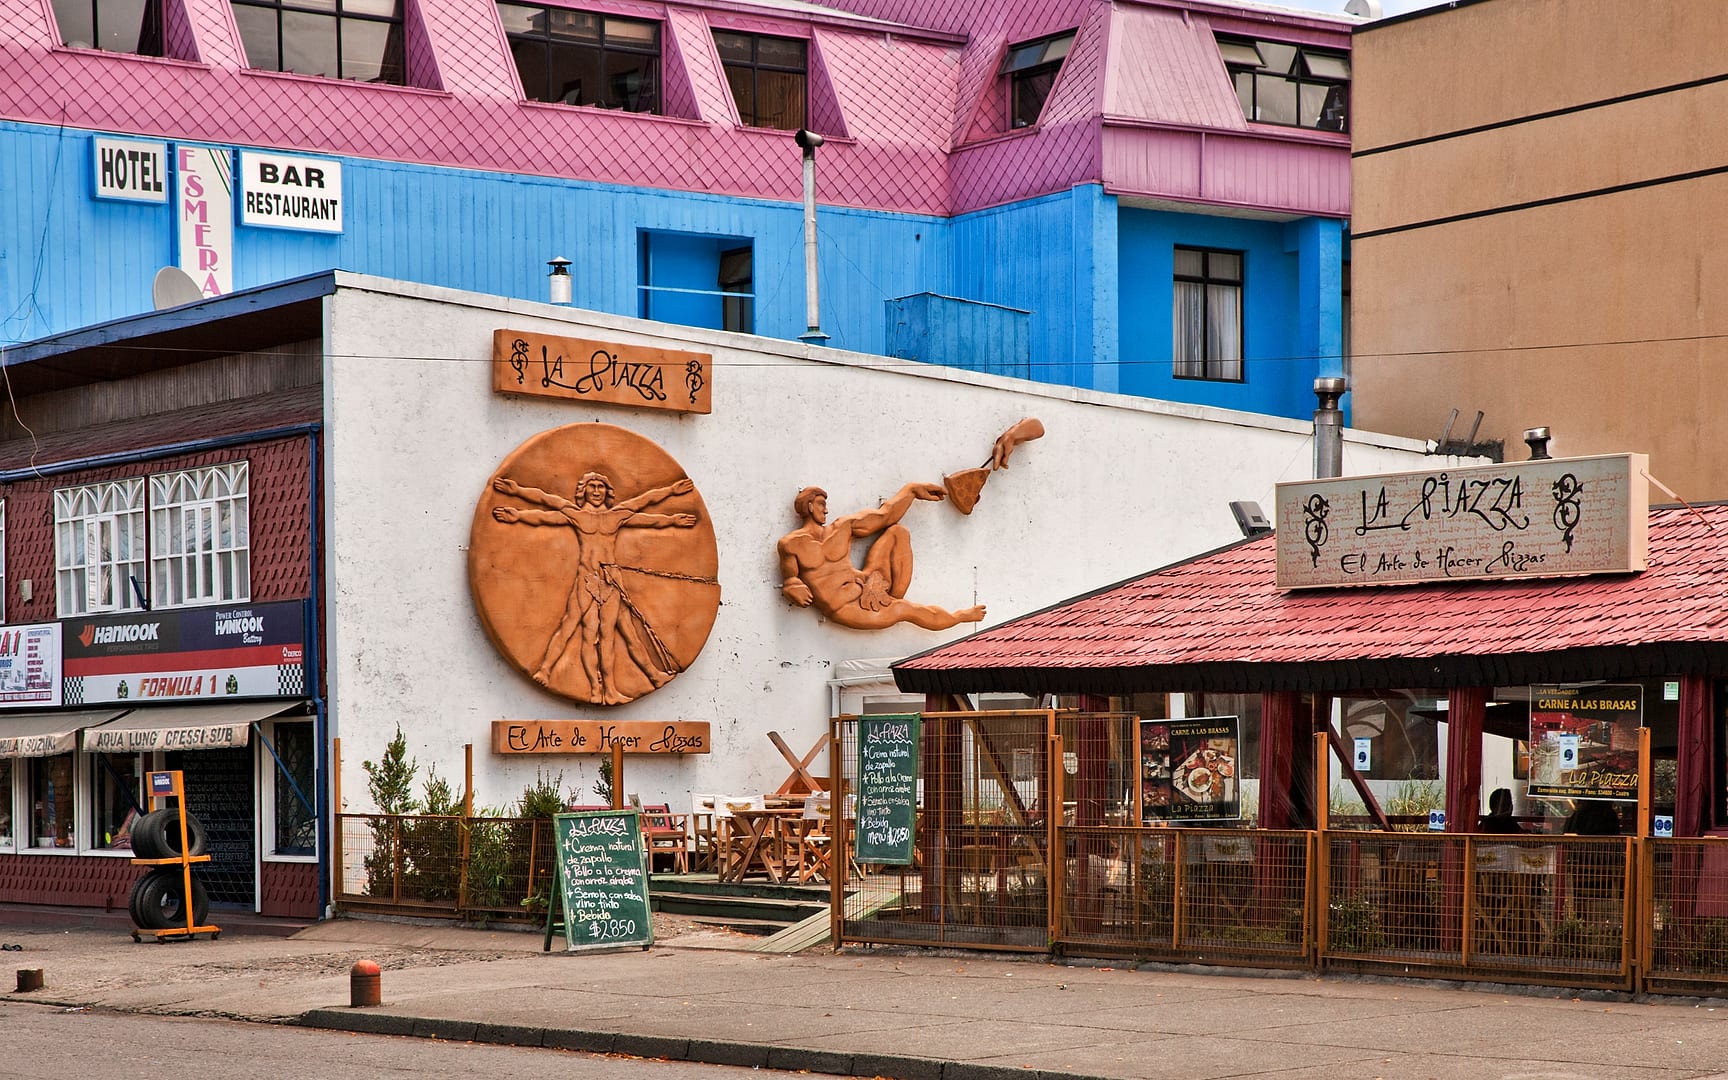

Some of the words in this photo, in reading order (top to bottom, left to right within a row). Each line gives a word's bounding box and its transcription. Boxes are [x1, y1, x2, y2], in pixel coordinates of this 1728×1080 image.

[101, 147, 163, 192] HOTEL
[259, 162, 325, 188] BAR
[246, 190, 338, 221] RESTAURANT
[1355, 485, 1404, 535] LA
[1403, 472, 1529, 531] PIAZZA
[1341, 556, 1366, 574] El
[1372, 550, 1406, 575] Arte
[1413, 550, 1430, 569] de
[1437, 546, 1483, 577] Hacer
[1485, 540, 1546, 573] Pizzas
[215, 616, 264, 636] HANKOOK
[139, 675, 202, 697] FORMULA
[209, 674, 217, 694] 1
[1539, 699, 1569, 709] CARNE
[1571, 700, 1579, 709] A
[1580, 700, 1598, 709] LAS
[1599, 700, 1636, 710] BRASAS
[508, 726, 529, 750] El
[529, 726, 563, 751] Arte
[571, 727, 587, 746] de
[650, 725, 703, 752] Pizzas
[868, 722, 880, 740] LA
[97, 732, 124, 747] AQUA
[129, 731, 158, 746] LUNG
[889, 744, 909, 758] natural
[865, 759, 874, 771] de
[1569, 770, 1586, 785] La
[1591, 768, 1638, 788] Piazza
[1171, 805, 1181, 813] La
[569, 819, 587, 834] LA
[571, 838, 605, 853] Crema
[608, 838, 635, 851] natural
[567, 855, 579, 864] de
[580, 852, 613, 866] zapallo
[571, 865, 593, 877] Pollo
[604, 865, 613, 875] la
[616, 868, 641, 876] crema
[571, 878, 584, 886] con
[585, 877, 607, 885] arroz
[624, 890, 643, 902] salsa
[575, 899, 596, 908] vino
[598, 899, 619, 909] tinto
[577, 909, 611, 922] Bebida
[589, 919, 636, 939] $2850
